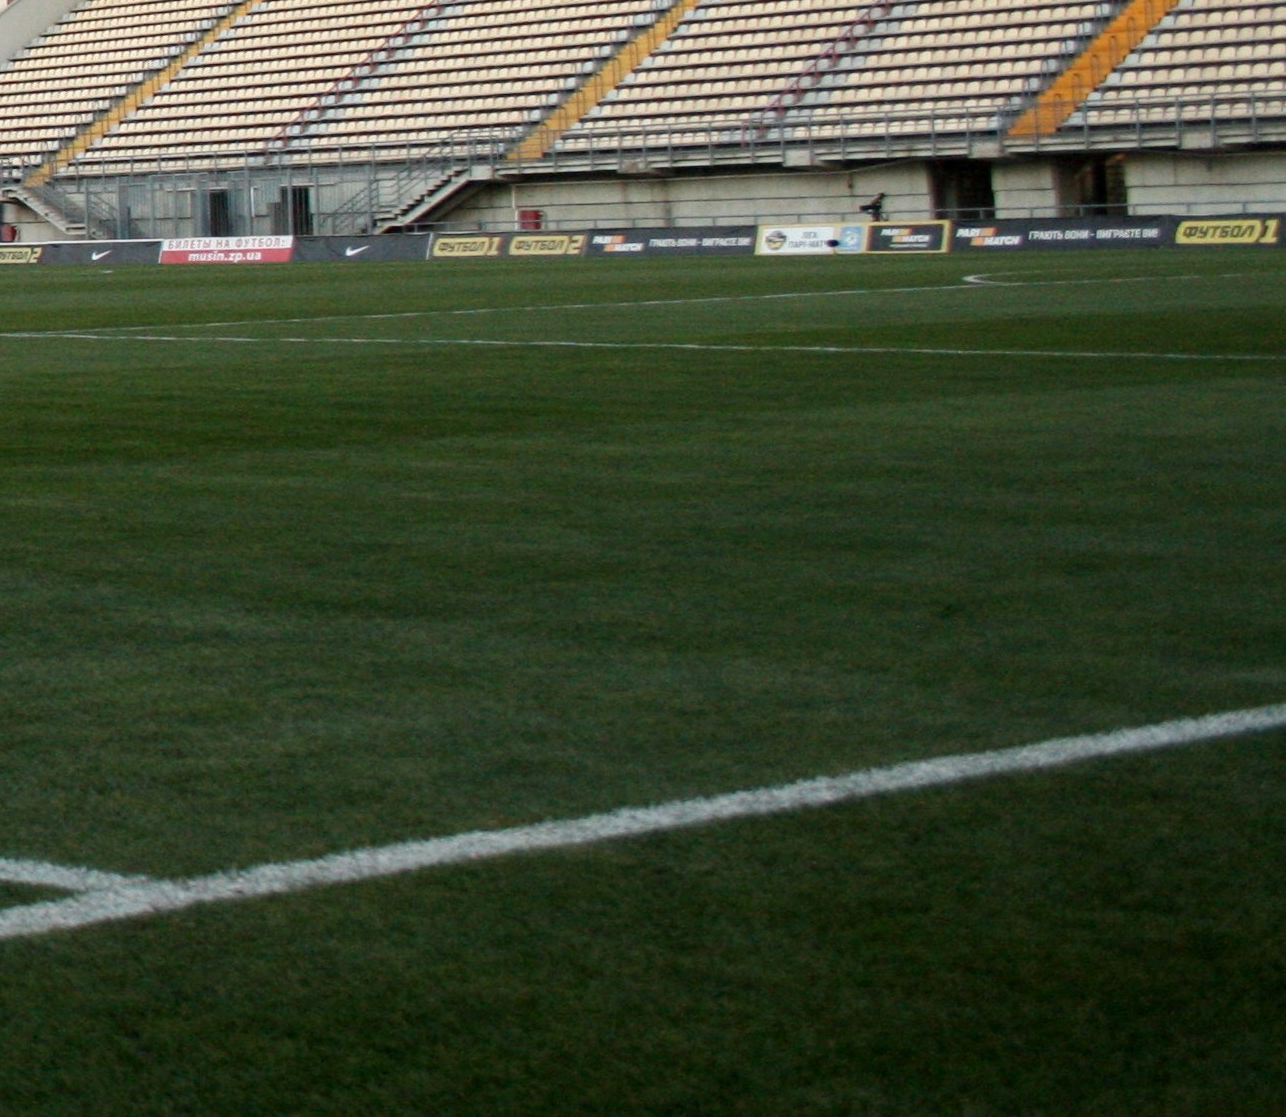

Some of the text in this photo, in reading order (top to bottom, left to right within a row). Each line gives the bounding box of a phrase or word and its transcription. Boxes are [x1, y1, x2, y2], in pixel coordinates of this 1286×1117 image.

[956, 228, 980, 237] PARI
[1182, 219, 1279, 243] ФУТБОЛ 1
[168, 236, 286, 250] БИЛЕТЫ НА ФУТБОЛ:
[984, 235, 1022, 245] MATCH
[188, 251, 262, 263] musin.zp.ua
